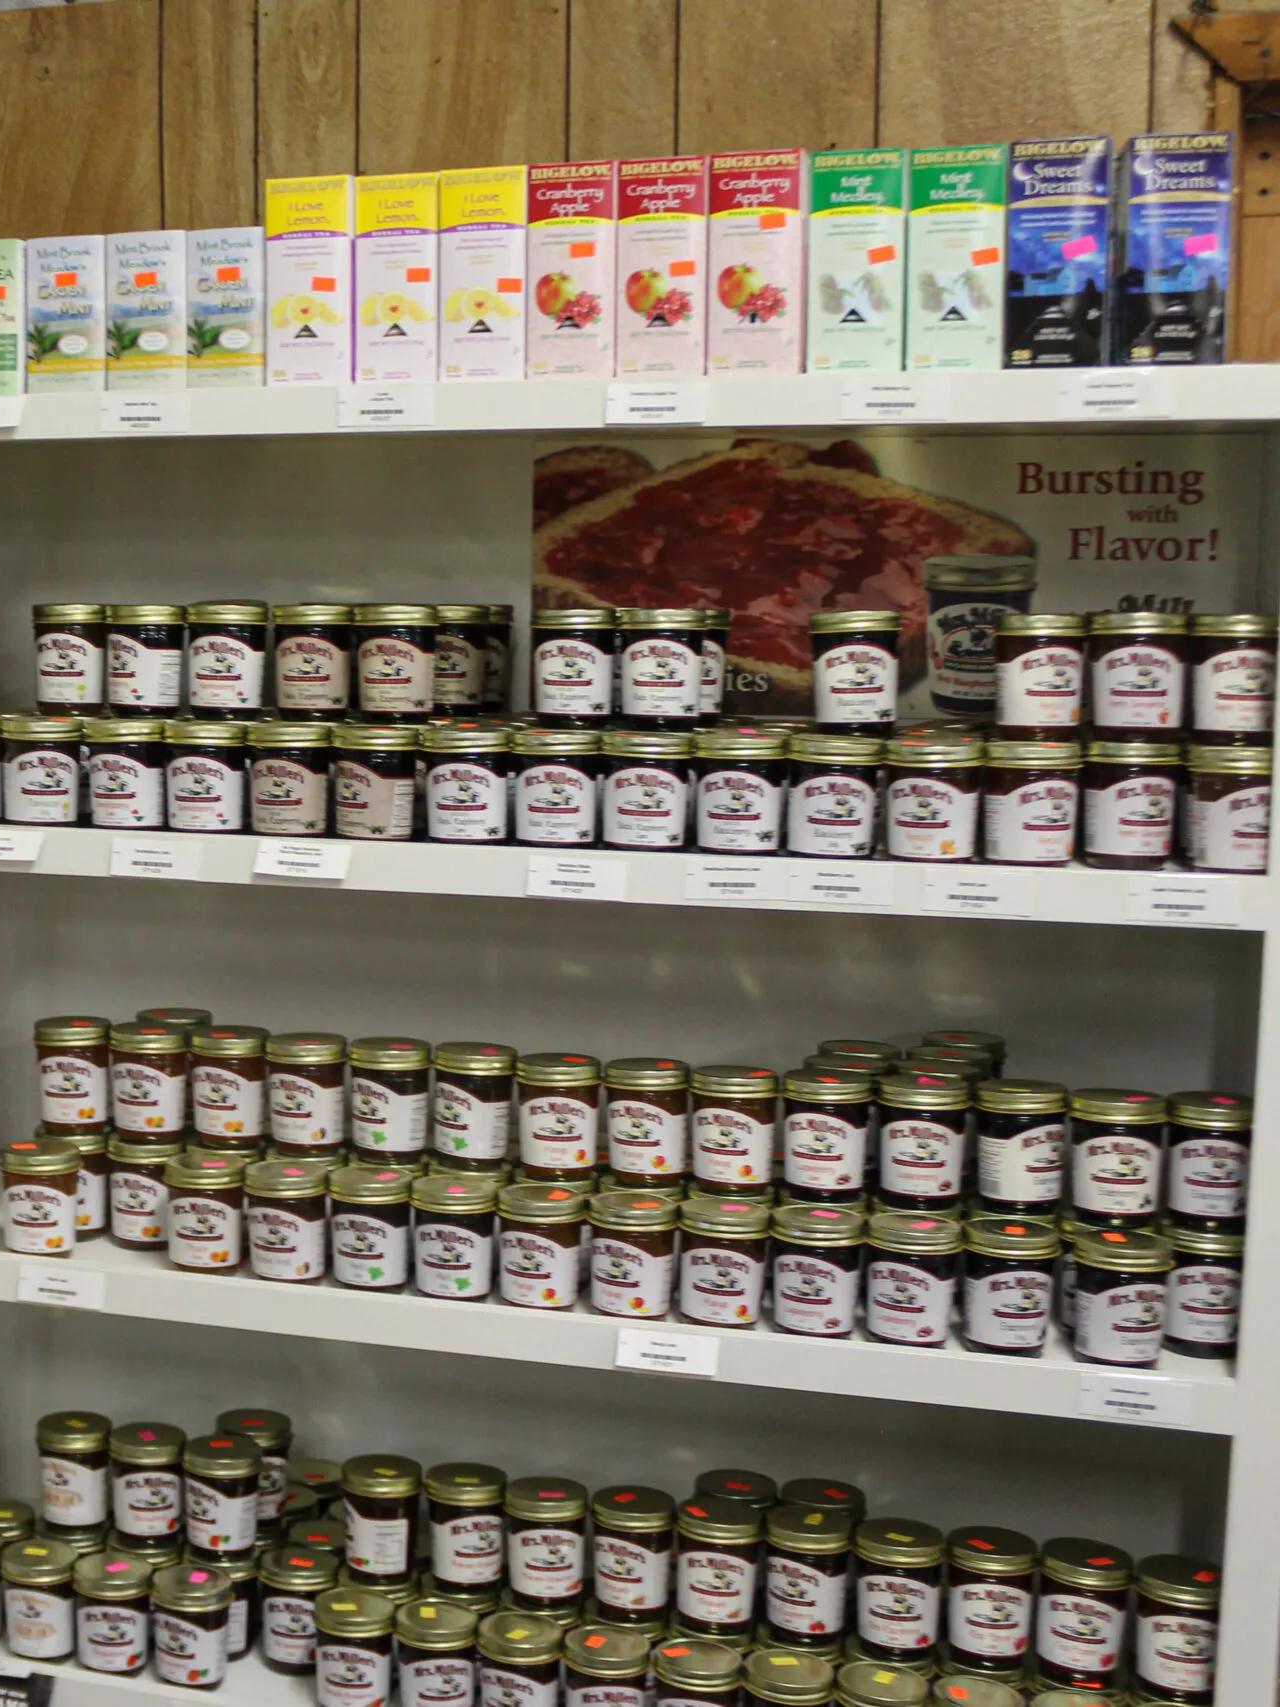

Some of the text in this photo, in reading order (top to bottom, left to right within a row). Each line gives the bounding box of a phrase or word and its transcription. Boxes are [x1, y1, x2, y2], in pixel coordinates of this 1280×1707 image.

[1015, 140, 1106, 156] BIGELOW
[1135, 136, 1228, 151] BIGELOW
[713, 155, 798, 170] BIGELOW
[815, 153, 900, 167] BIGELOW
[914, 149, 1000, 164] BIGELOW
[531, 164, 611, 180] BIGELOW
[621, 159, 704, 175] BIGELOW
[1032, 164, 1083, 178] Sweet
[1152, 159, 1206, 173] Sweet
[626, 180, 696, 197] Cranberry
[719, 174, 791, 192] Cranberry
[1024, 180, 1092, 195] Dreams
[1146, 175, 1215, 190] Dreams
[470, 193, 499, 203] Love
[537, 184, 604, 201] Cranberry
[733, 192, 776, 208] Apple
[295, 201, 324, 211] Love
[384, 199, 414, 209] Love
[550, 202, 590, 216] Apple
[641, 198, 681, 213] Apple
[1017, 461, 1205, 505] Bursting
[1127, 505, 1179, 523] with
[1068, 525, 1219, 561] Flavor!
